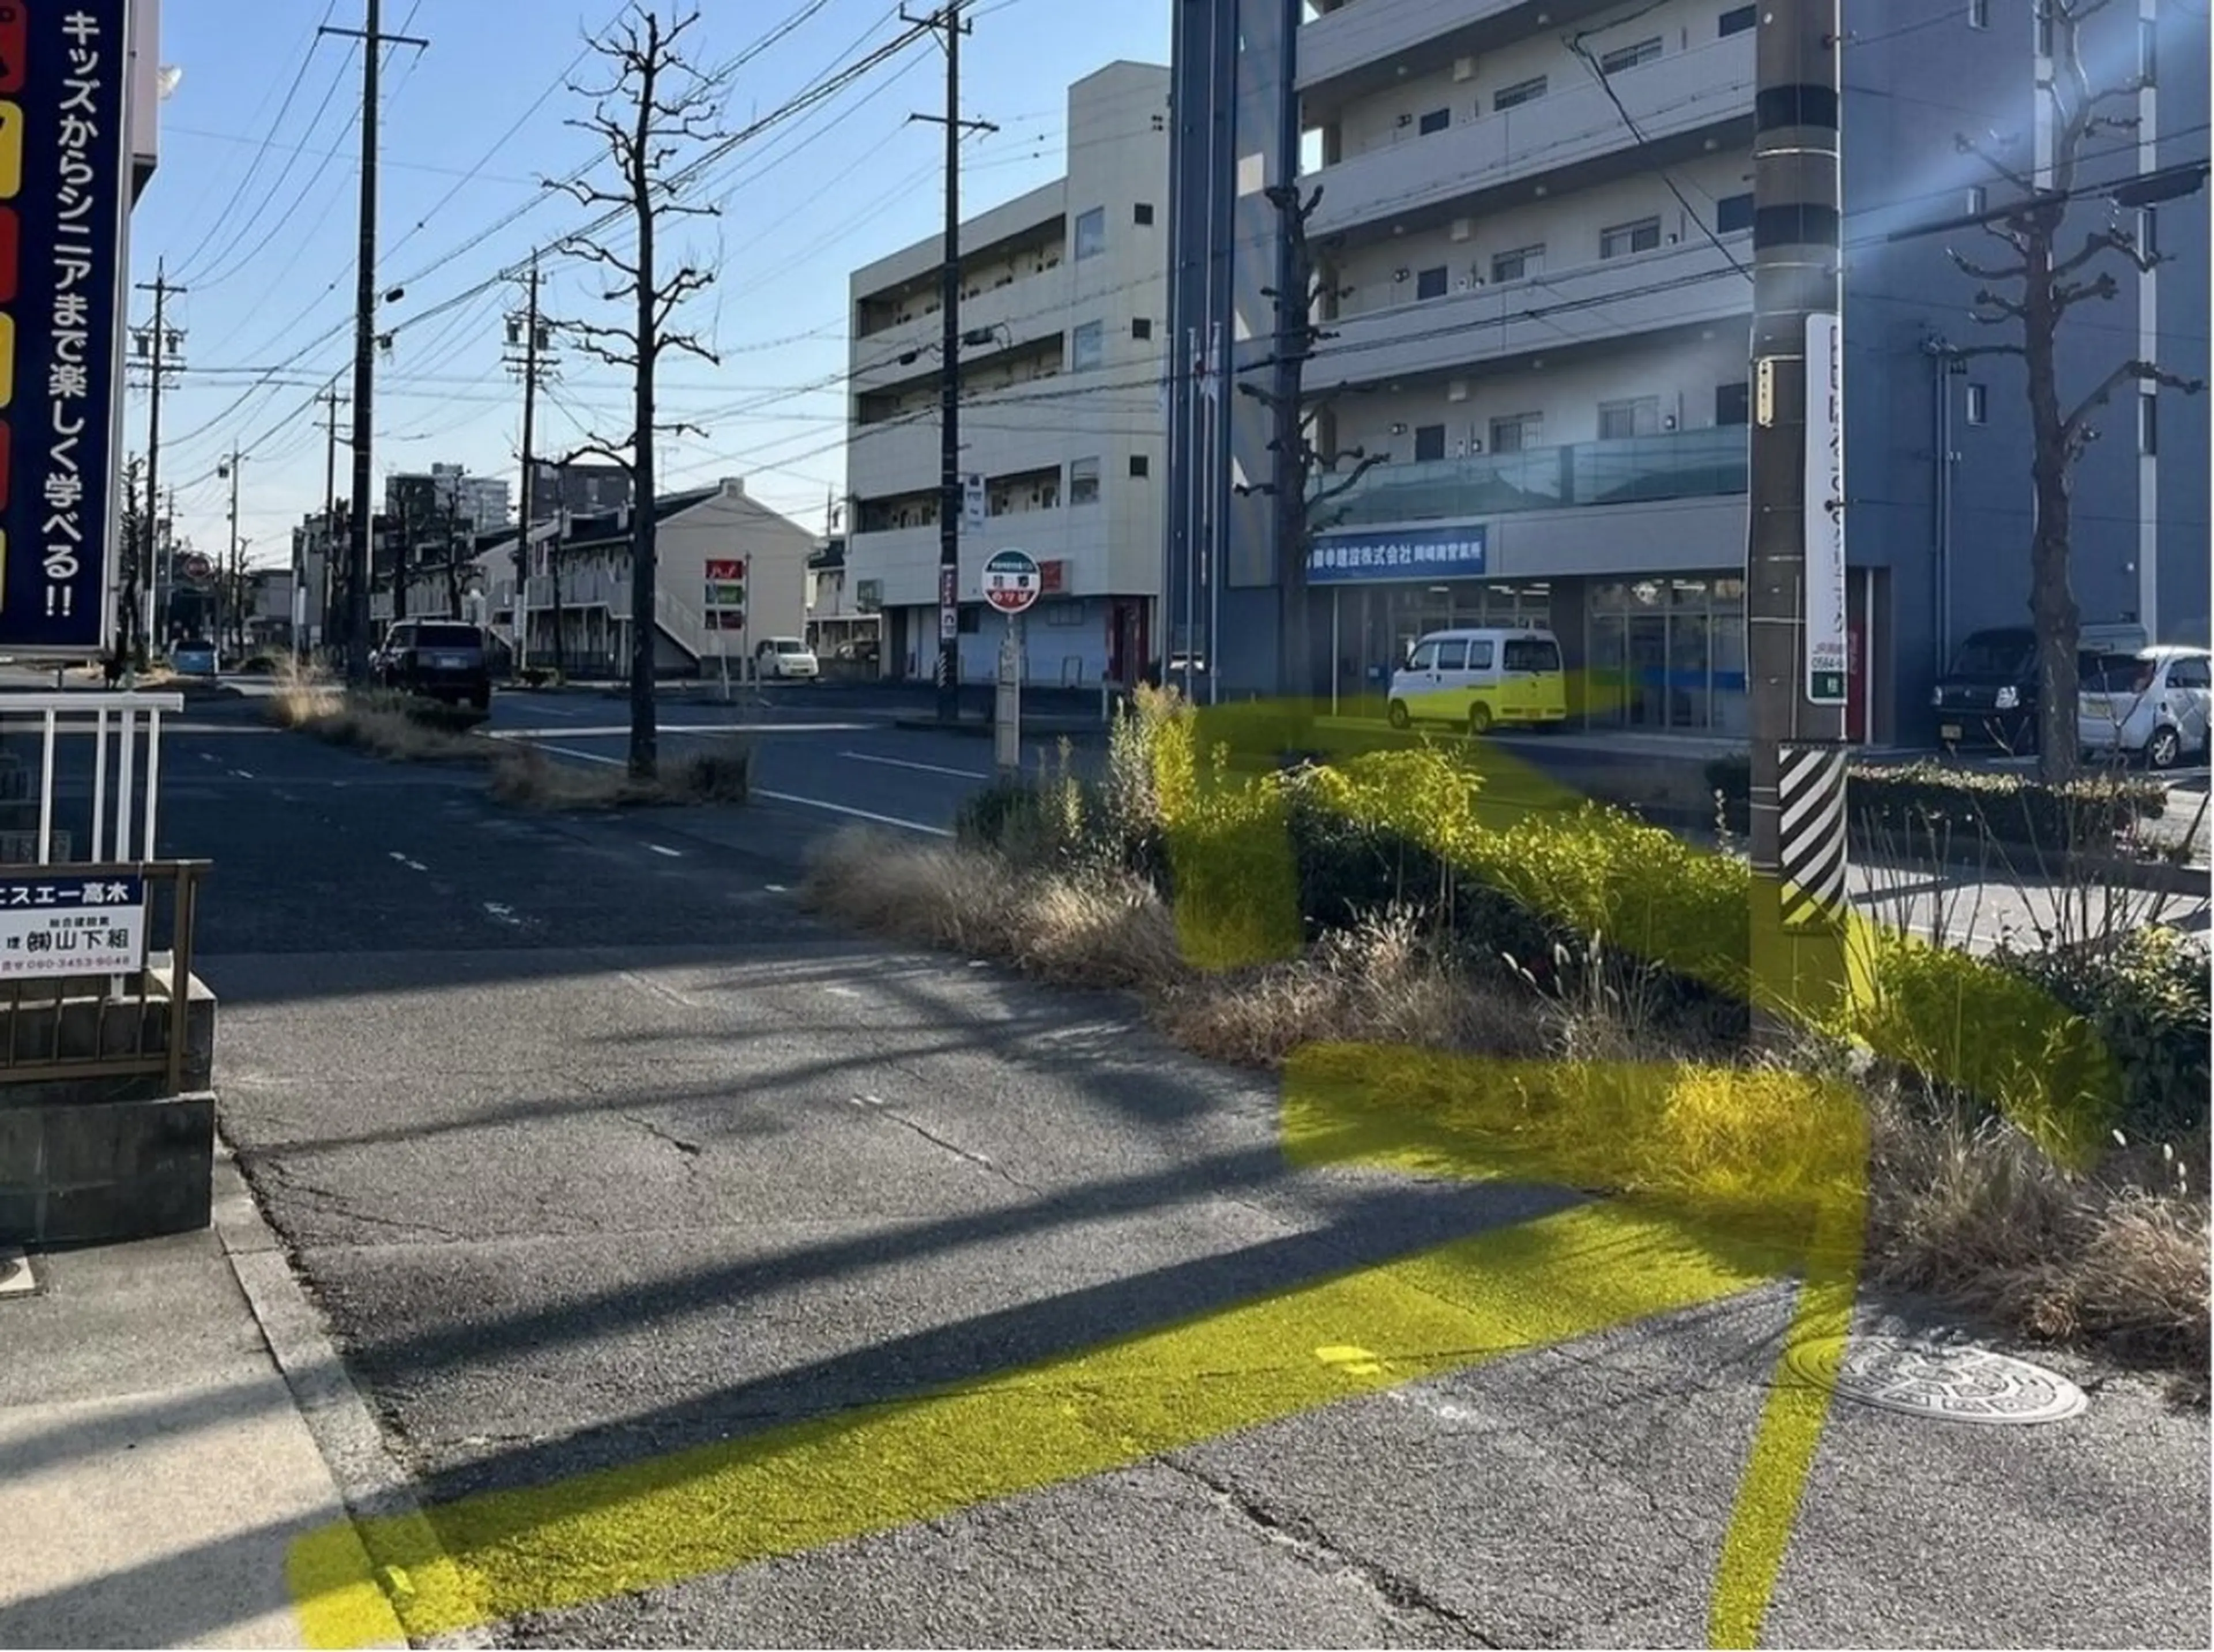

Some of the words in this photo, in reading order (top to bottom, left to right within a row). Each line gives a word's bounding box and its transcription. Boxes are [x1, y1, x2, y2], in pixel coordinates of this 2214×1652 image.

[42, 10, 101, 617] キッズからシニアまで楽しく学べる!!
